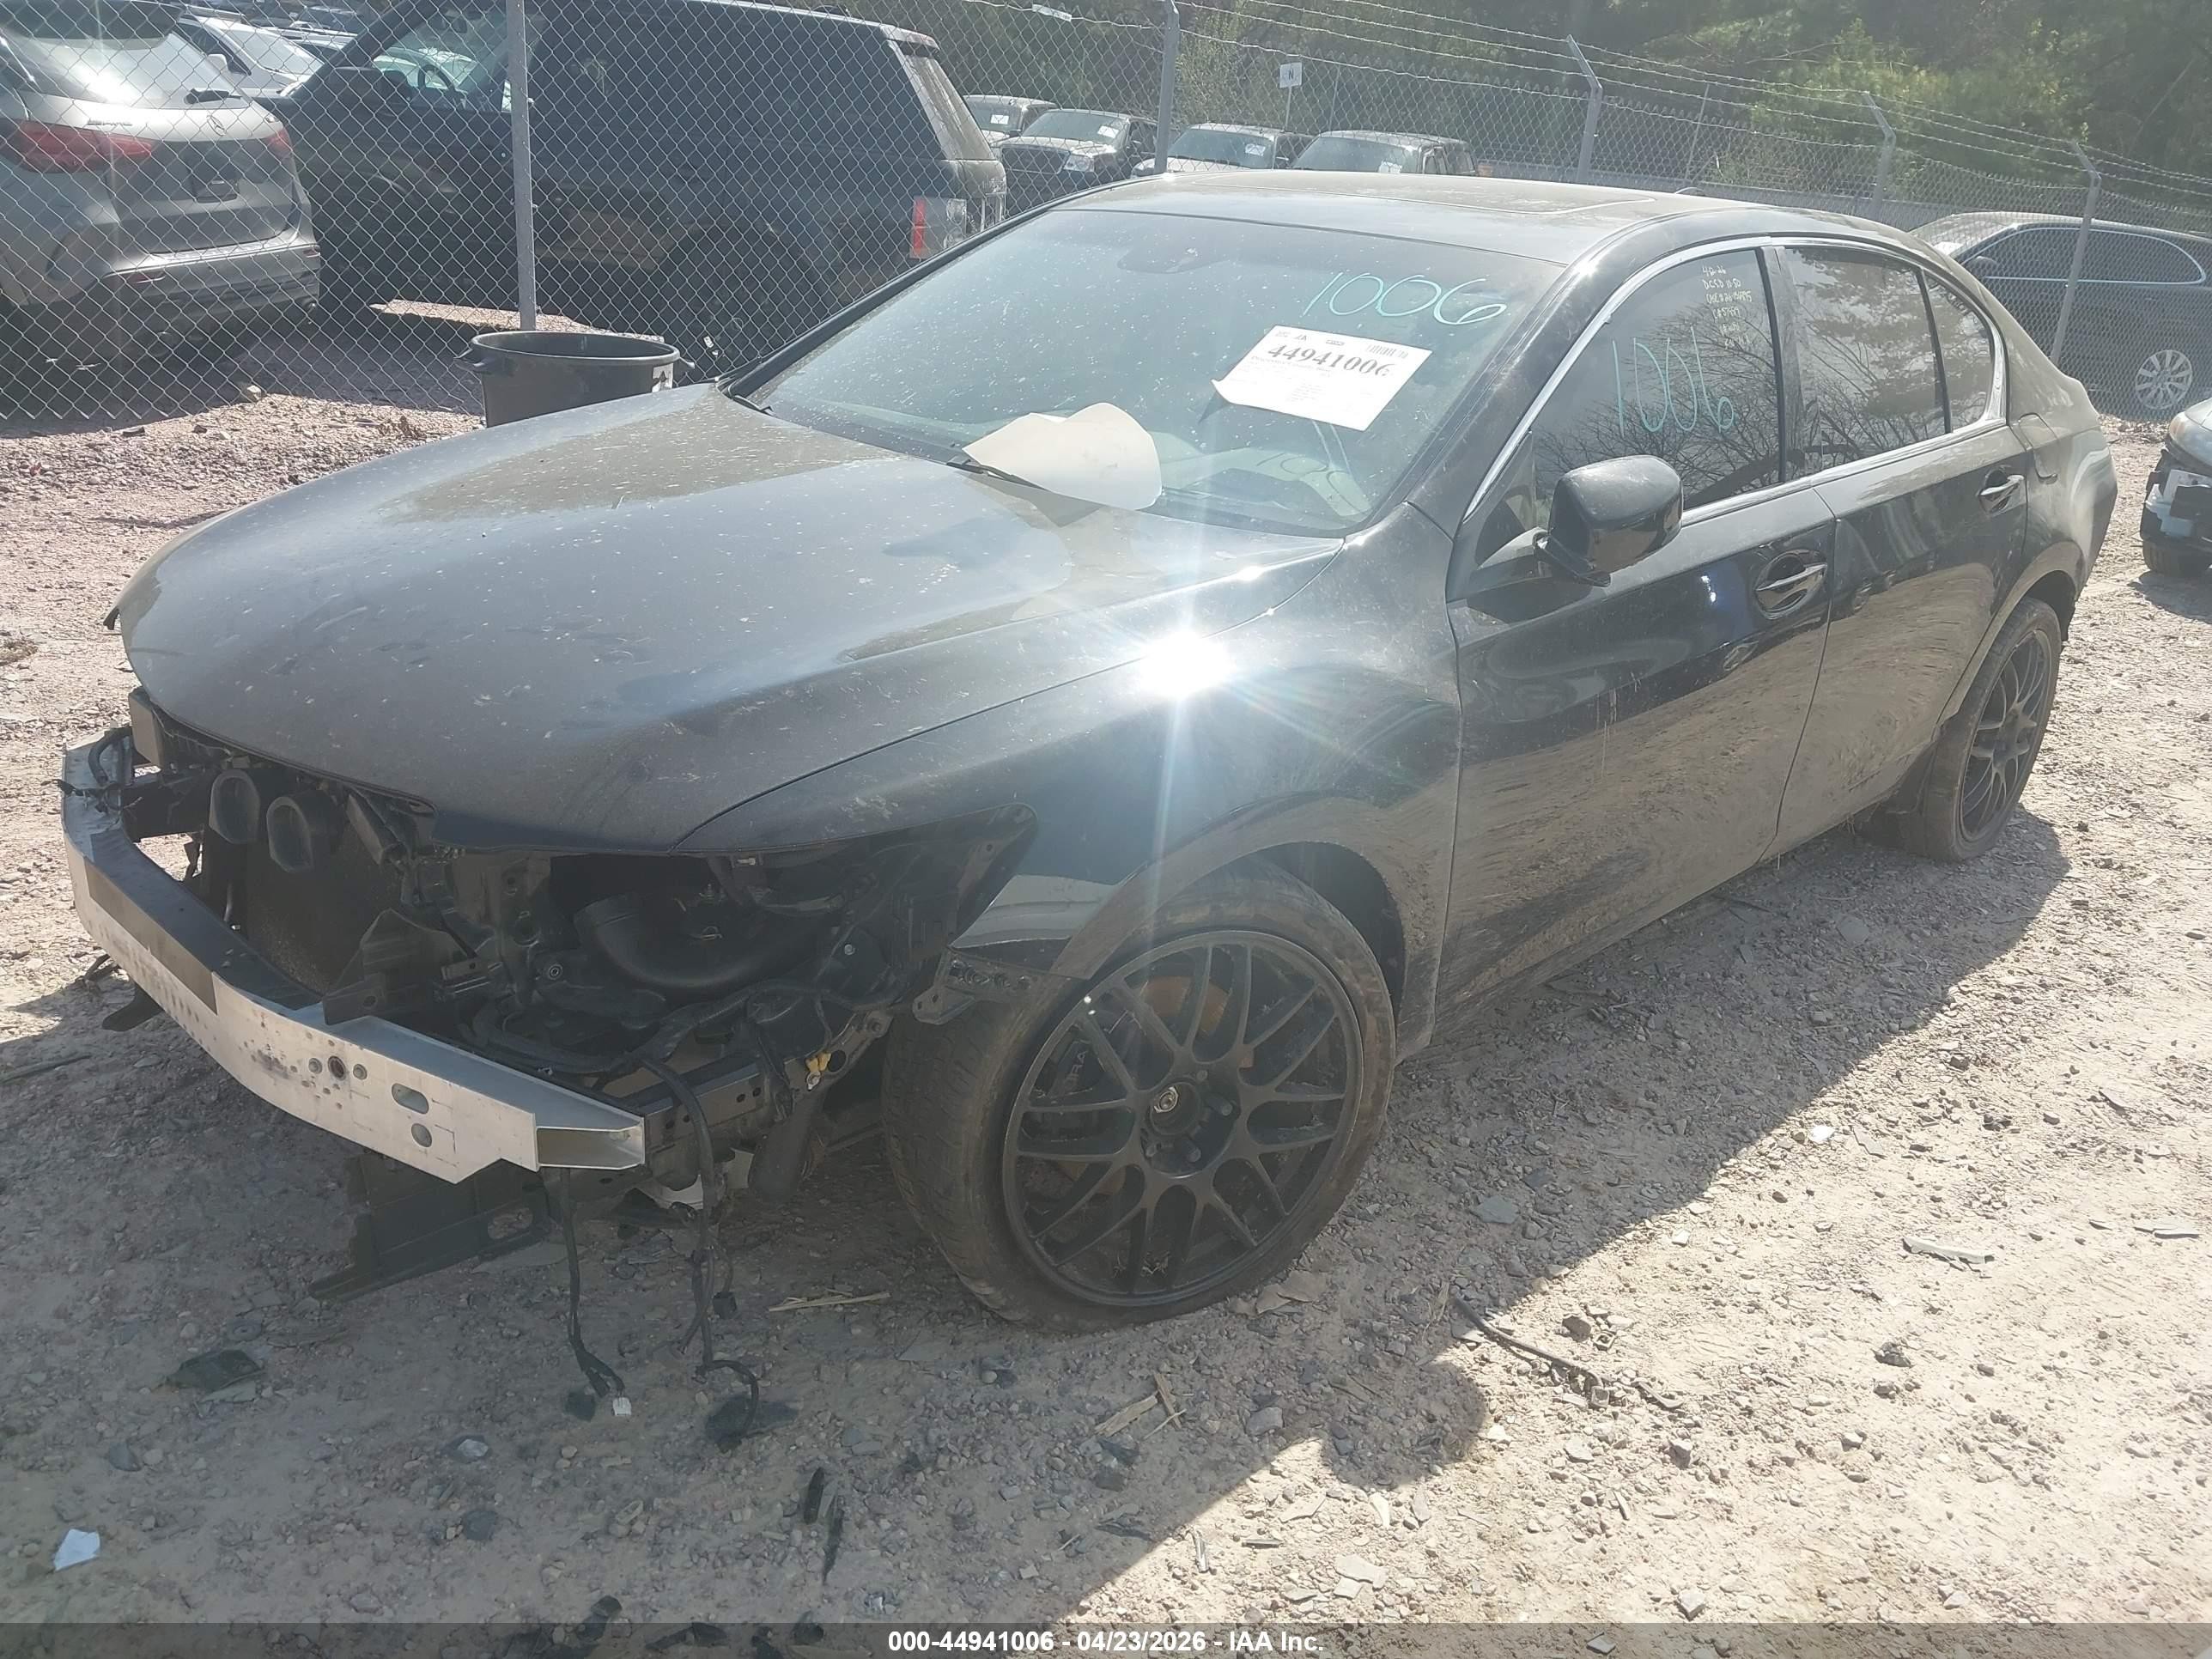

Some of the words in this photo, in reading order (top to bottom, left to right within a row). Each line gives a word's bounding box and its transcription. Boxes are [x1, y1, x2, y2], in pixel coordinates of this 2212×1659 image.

[1303, 272, 1507, 325] 1006
[1267, 344, 1395, 376] 44941006
[1612, 325, 1735, 439] 1006
